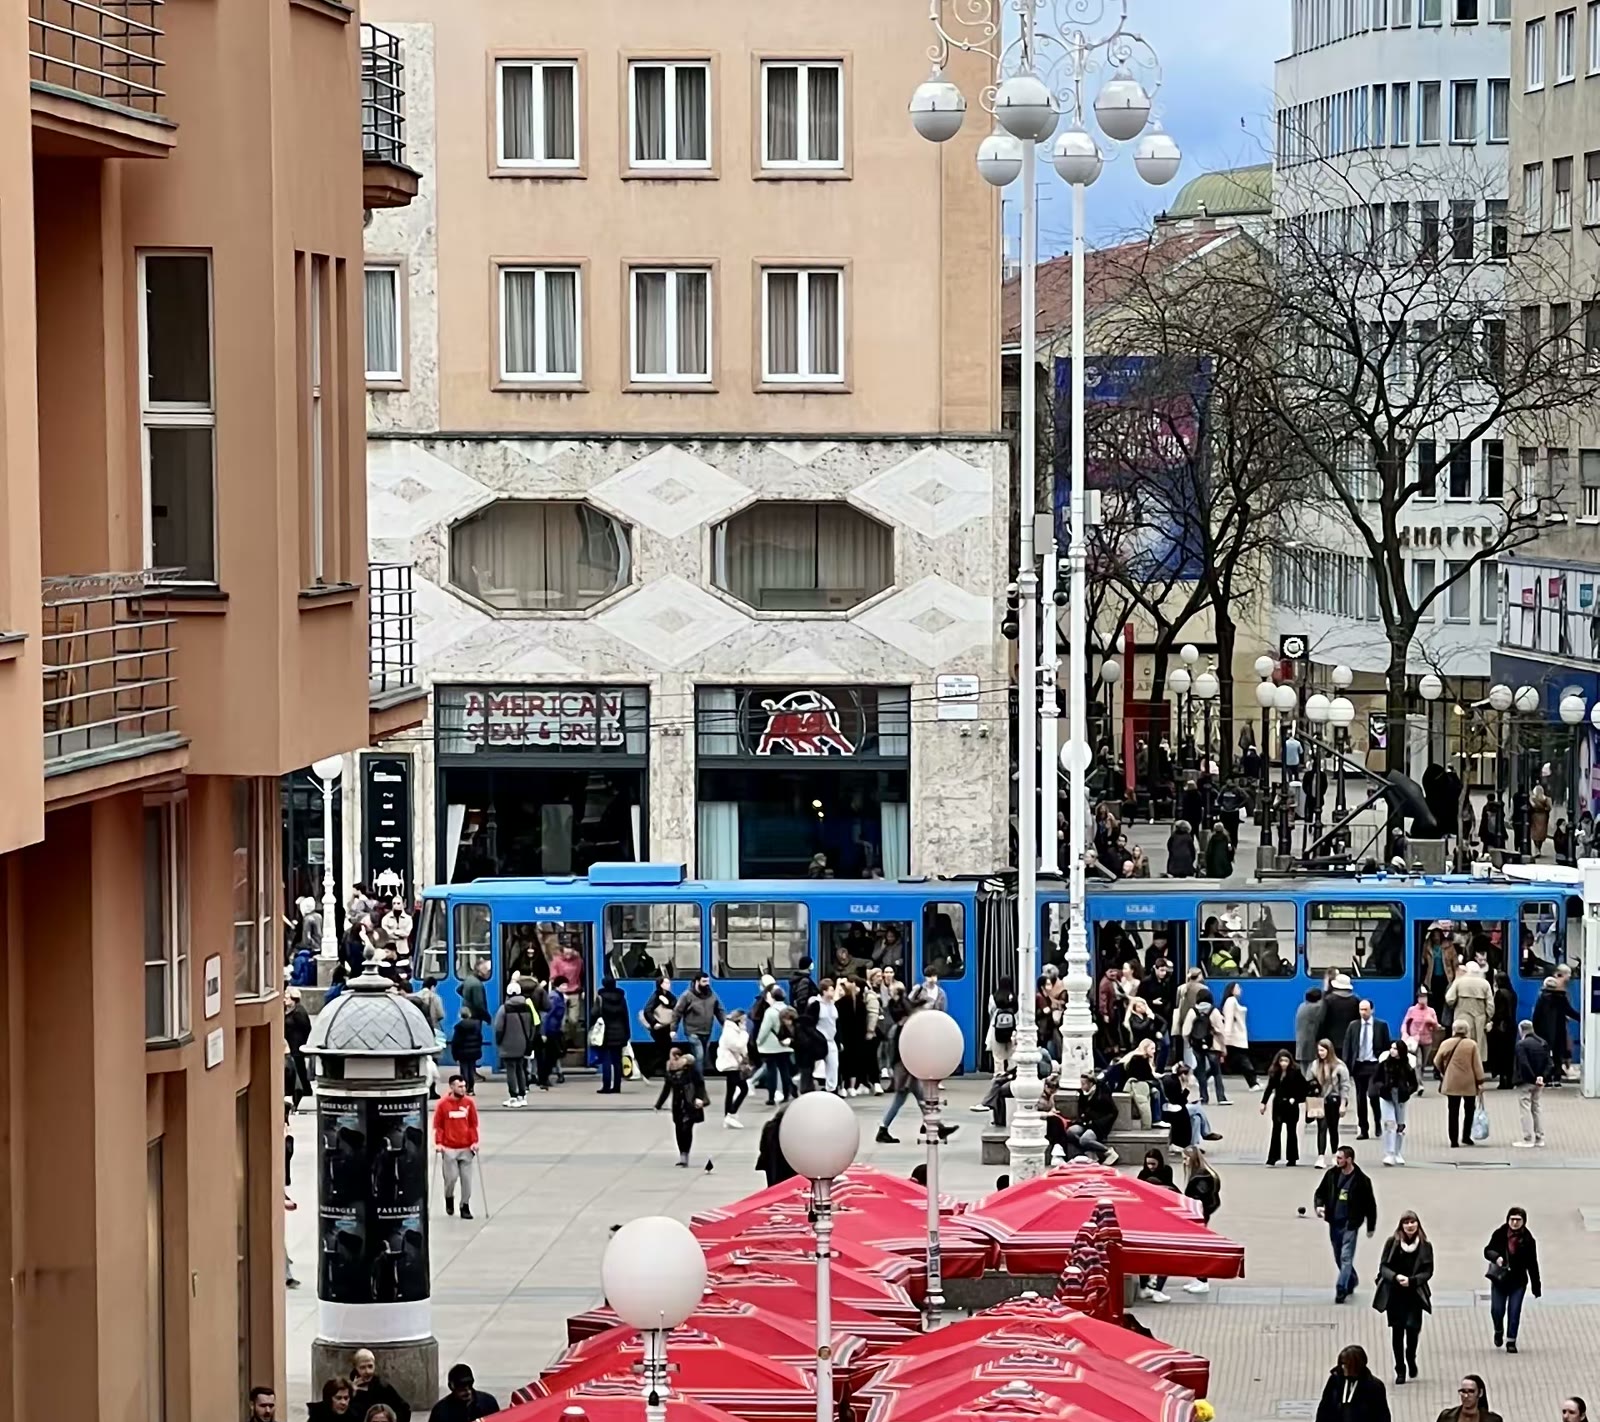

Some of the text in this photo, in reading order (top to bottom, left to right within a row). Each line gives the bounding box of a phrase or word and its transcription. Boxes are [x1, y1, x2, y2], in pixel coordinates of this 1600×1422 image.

[466, 694, 618, 717] AMERICAN
[1450, 904, 1478, 913] ULAZ
[377, 1102, 421, 1110] PASSENGER
